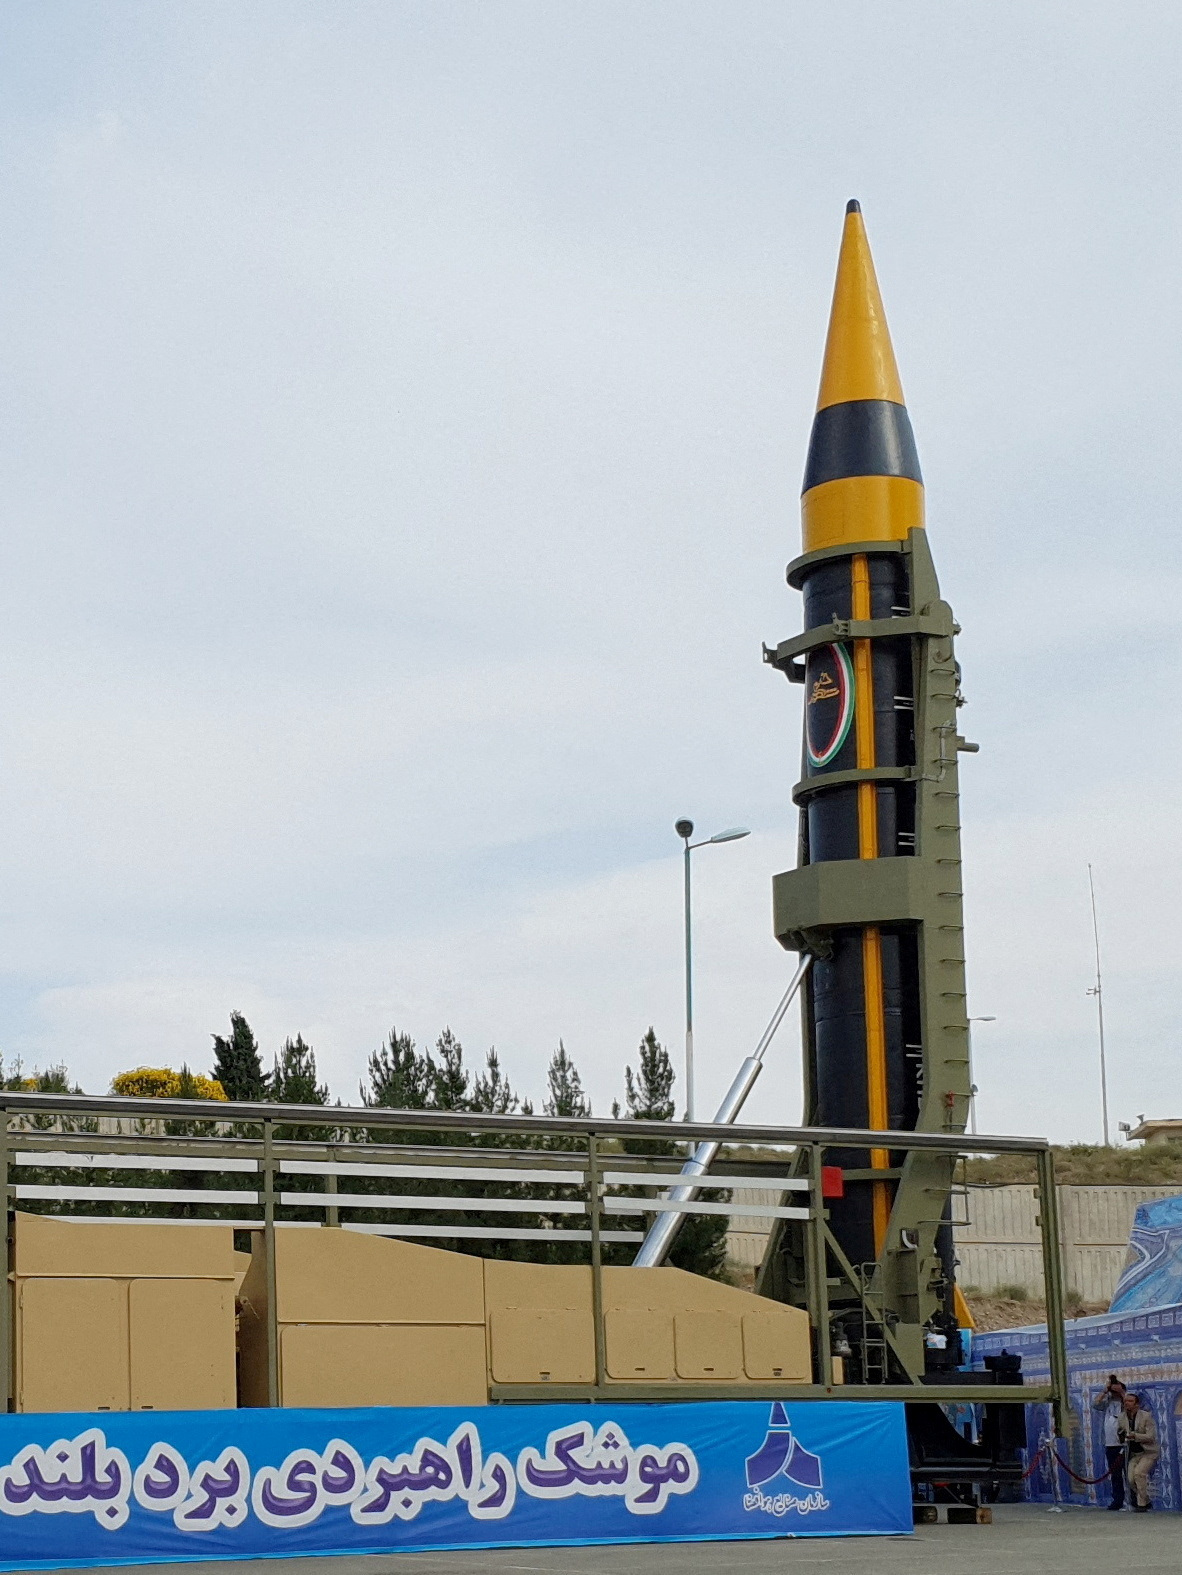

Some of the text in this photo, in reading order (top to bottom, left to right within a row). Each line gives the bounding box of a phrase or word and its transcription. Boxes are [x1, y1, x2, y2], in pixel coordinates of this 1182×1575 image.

[1, 1426, 695, 1524] موشک راهبردی برد بلند
[798, 1491, 829, 1515] سازمان
